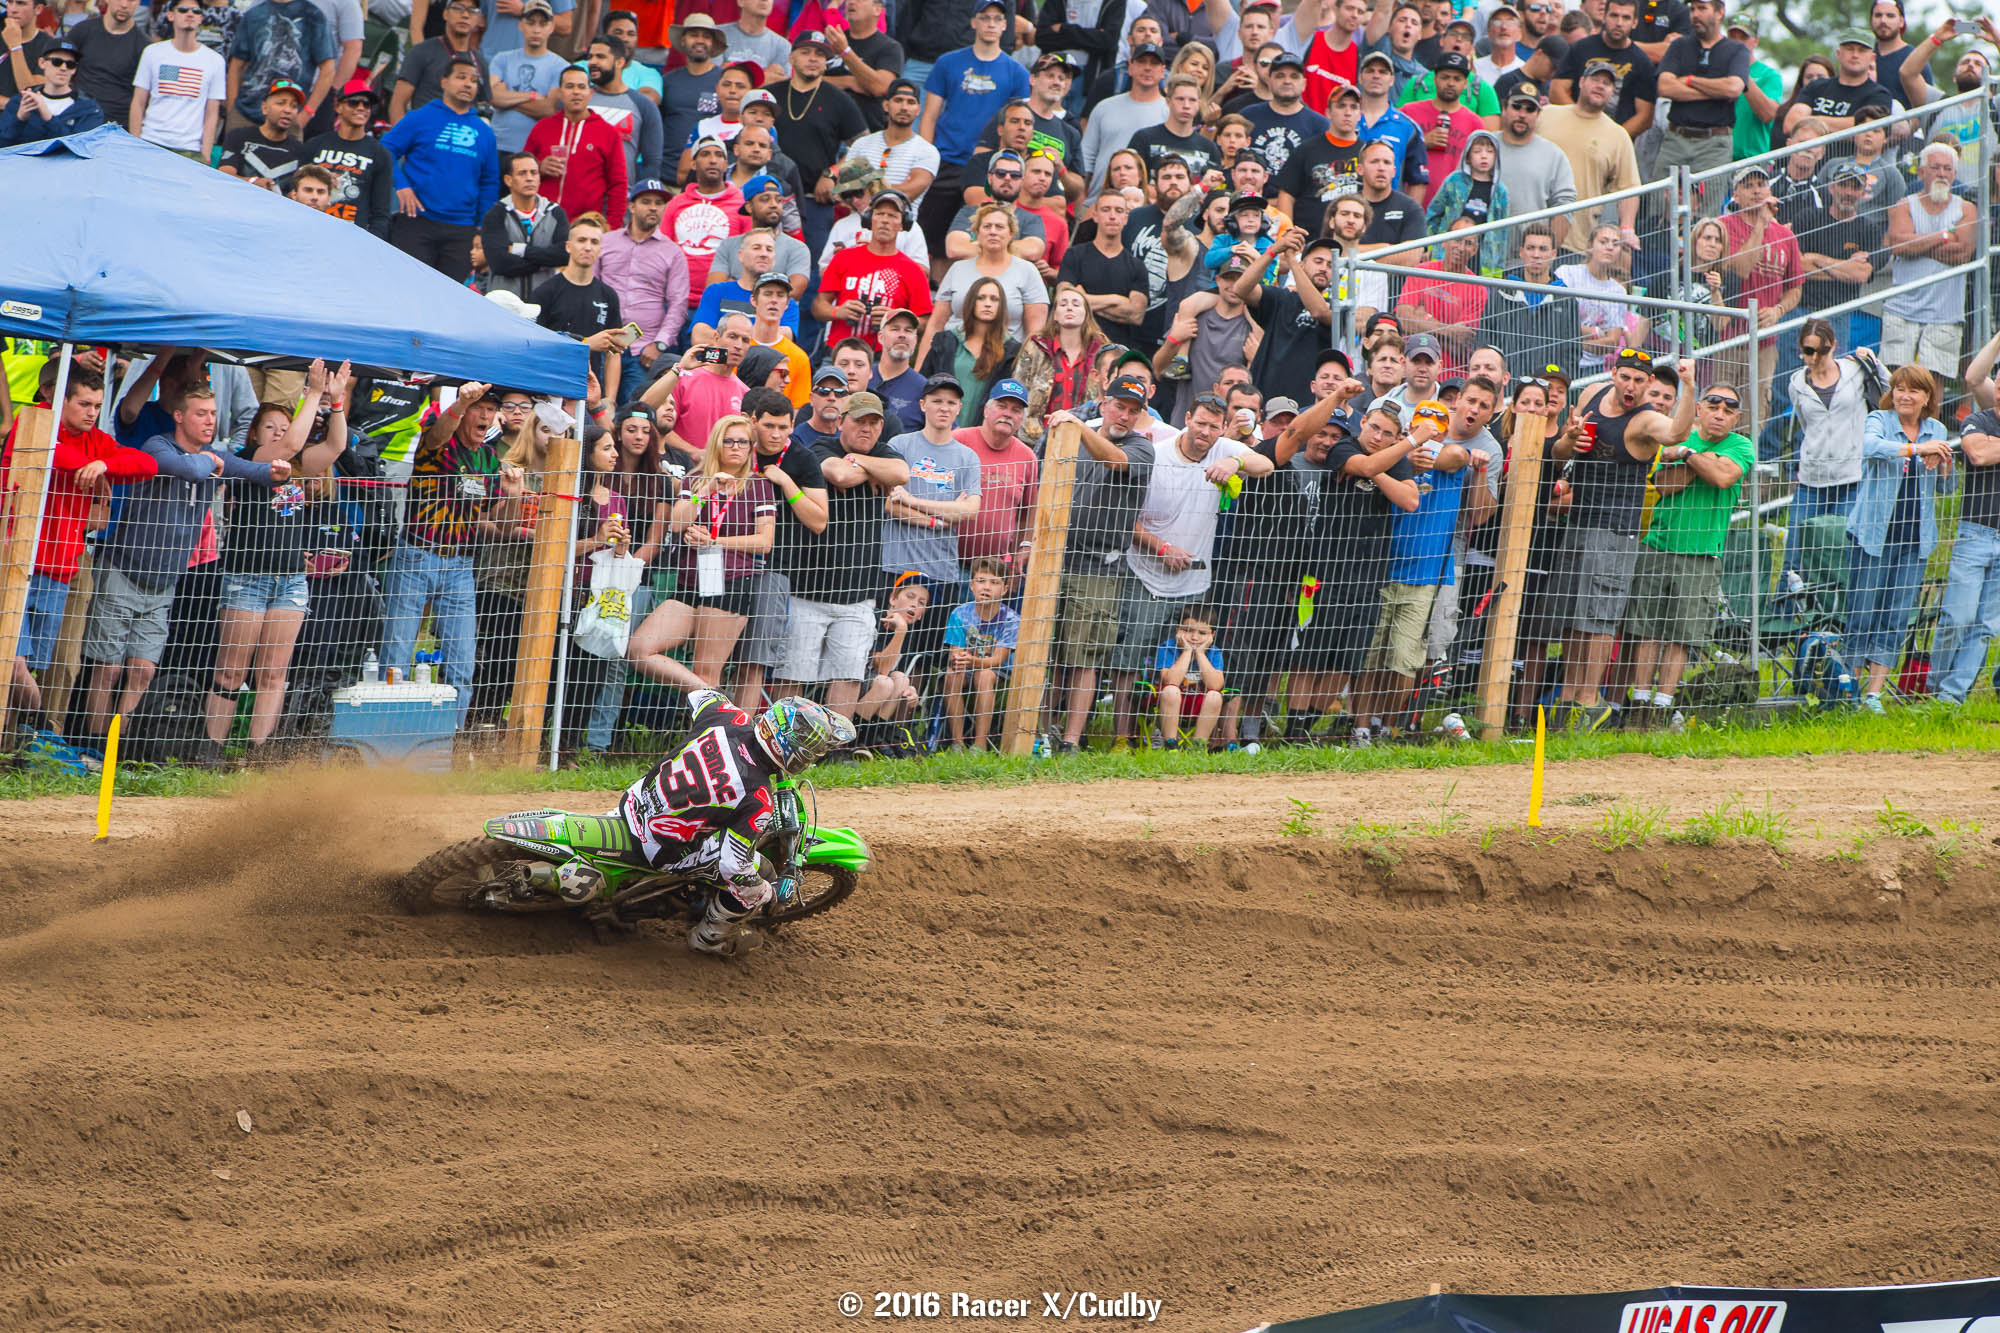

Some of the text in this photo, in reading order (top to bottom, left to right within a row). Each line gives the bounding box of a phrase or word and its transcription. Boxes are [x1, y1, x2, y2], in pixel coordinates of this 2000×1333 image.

[313, 150, 373, 171] JUST
[760, 720, 773, 739] 3
[660, 750, 712, 810] 3
[697, 729, 738, 805] TOMAC
[516, 838, 560, 855] DUNLOP
[559, 866, 603, 899] 3
[1628, 1304, 1778, 1333] LUCAS OIL
